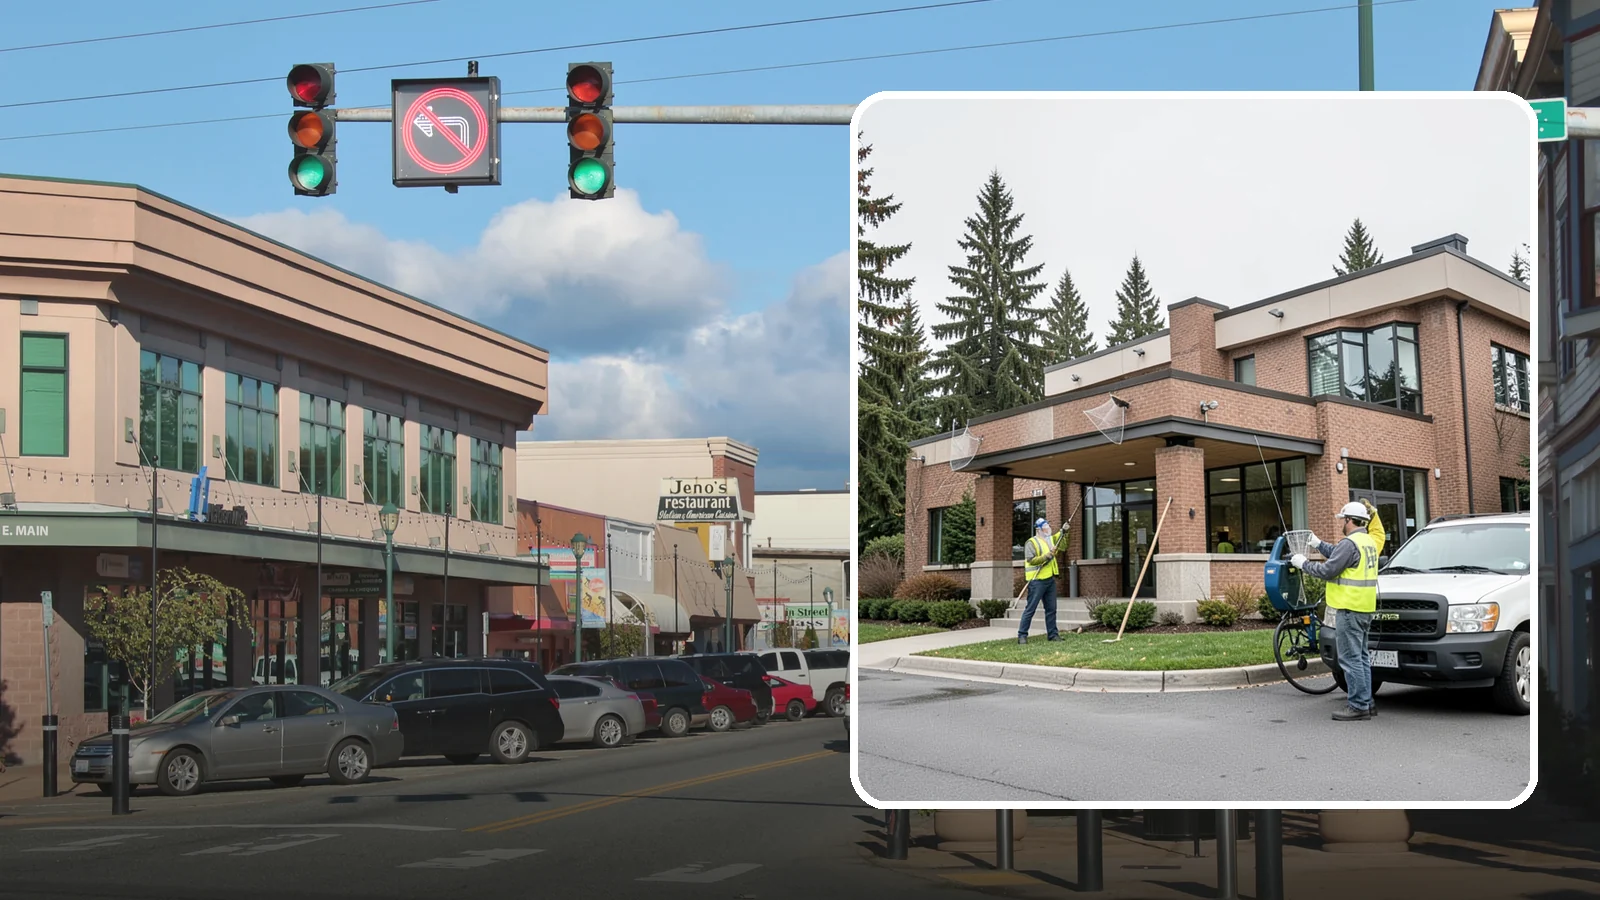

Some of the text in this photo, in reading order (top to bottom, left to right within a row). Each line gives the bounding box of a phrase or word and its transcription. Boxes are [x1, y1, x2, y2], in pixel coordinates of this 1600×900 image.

[670, 480, 727, 494] Jeno's
[665, 496, 731, 509] restaurant
[658, 509, 681, 519] Italian
[686, 509, 714, 519] American
[714, 509, 738, 519] Cuisine
[2, 525, 48, 536] E. MAIN
[797, 607, 828, 617] Street
